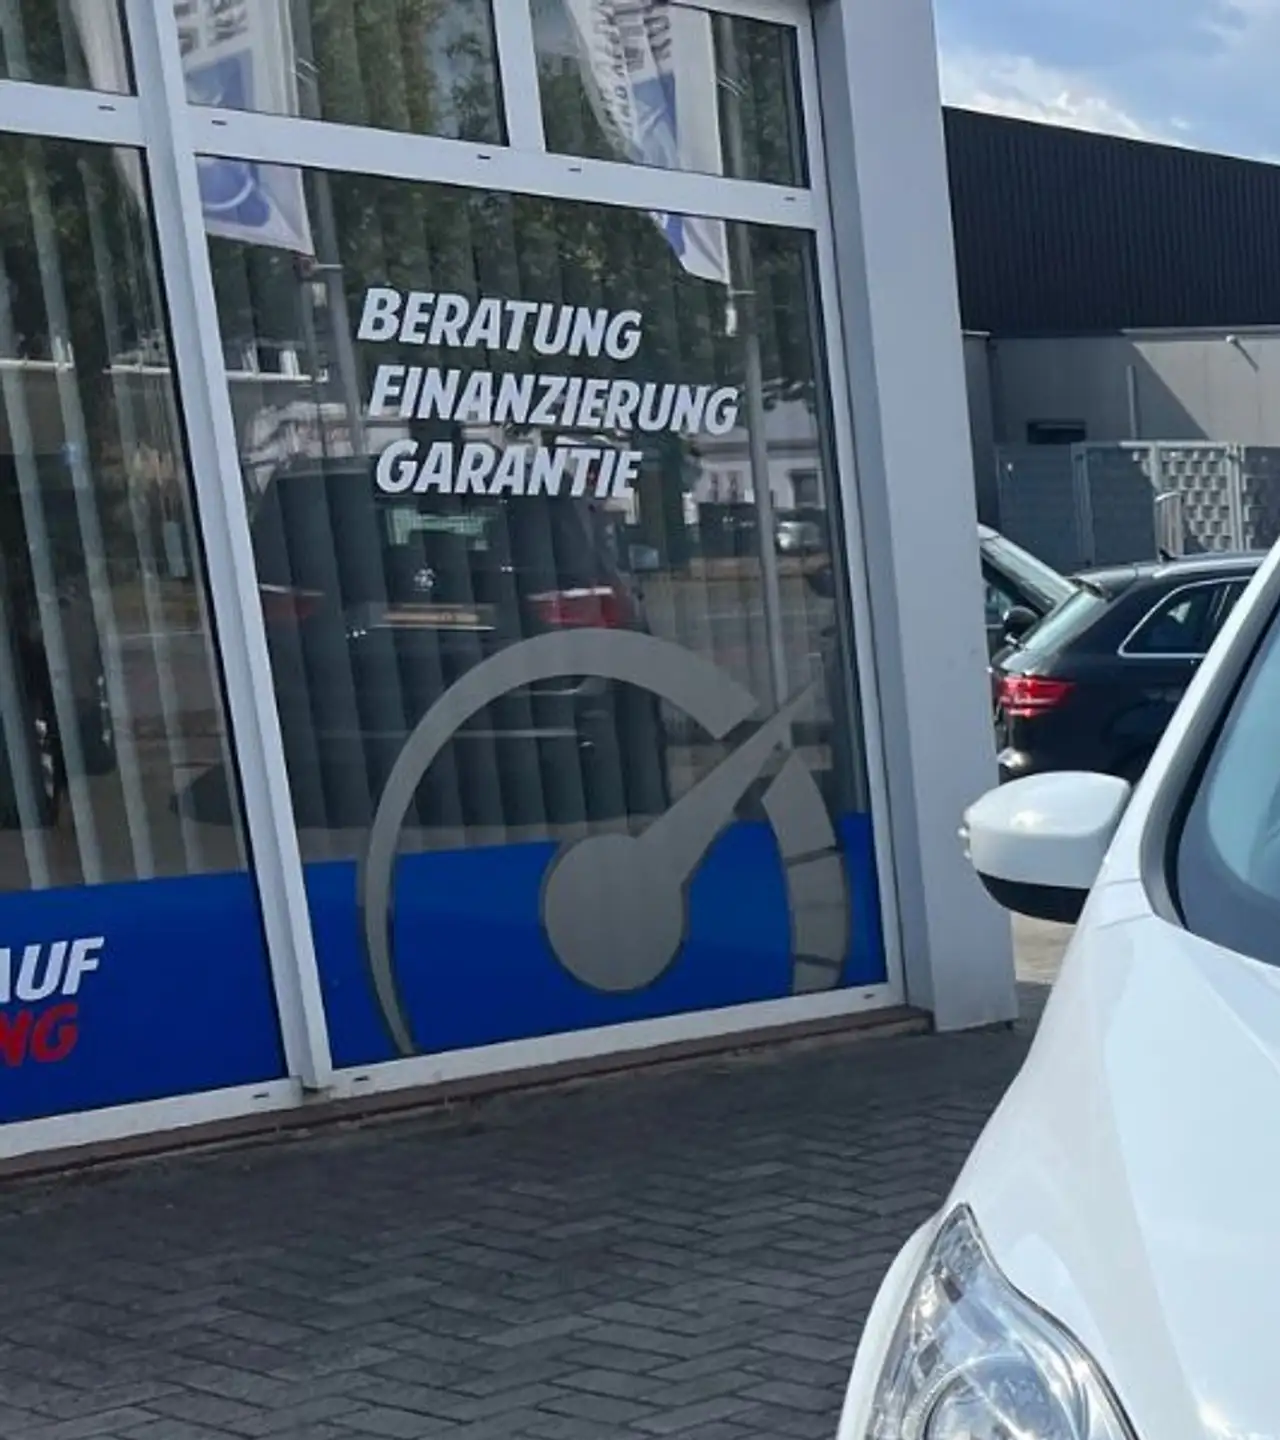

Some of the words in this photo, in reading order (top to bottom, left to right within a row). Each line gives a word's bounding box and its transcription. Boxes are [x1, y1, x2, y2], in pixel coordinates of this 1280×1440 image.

[357, 287, 643, 360] BERATUNG
[368, 364, 739, 436] FINANZIERUNG
[375, 440, 643, 499] GARANTIE
[0, 936, 105, 1003] UF
